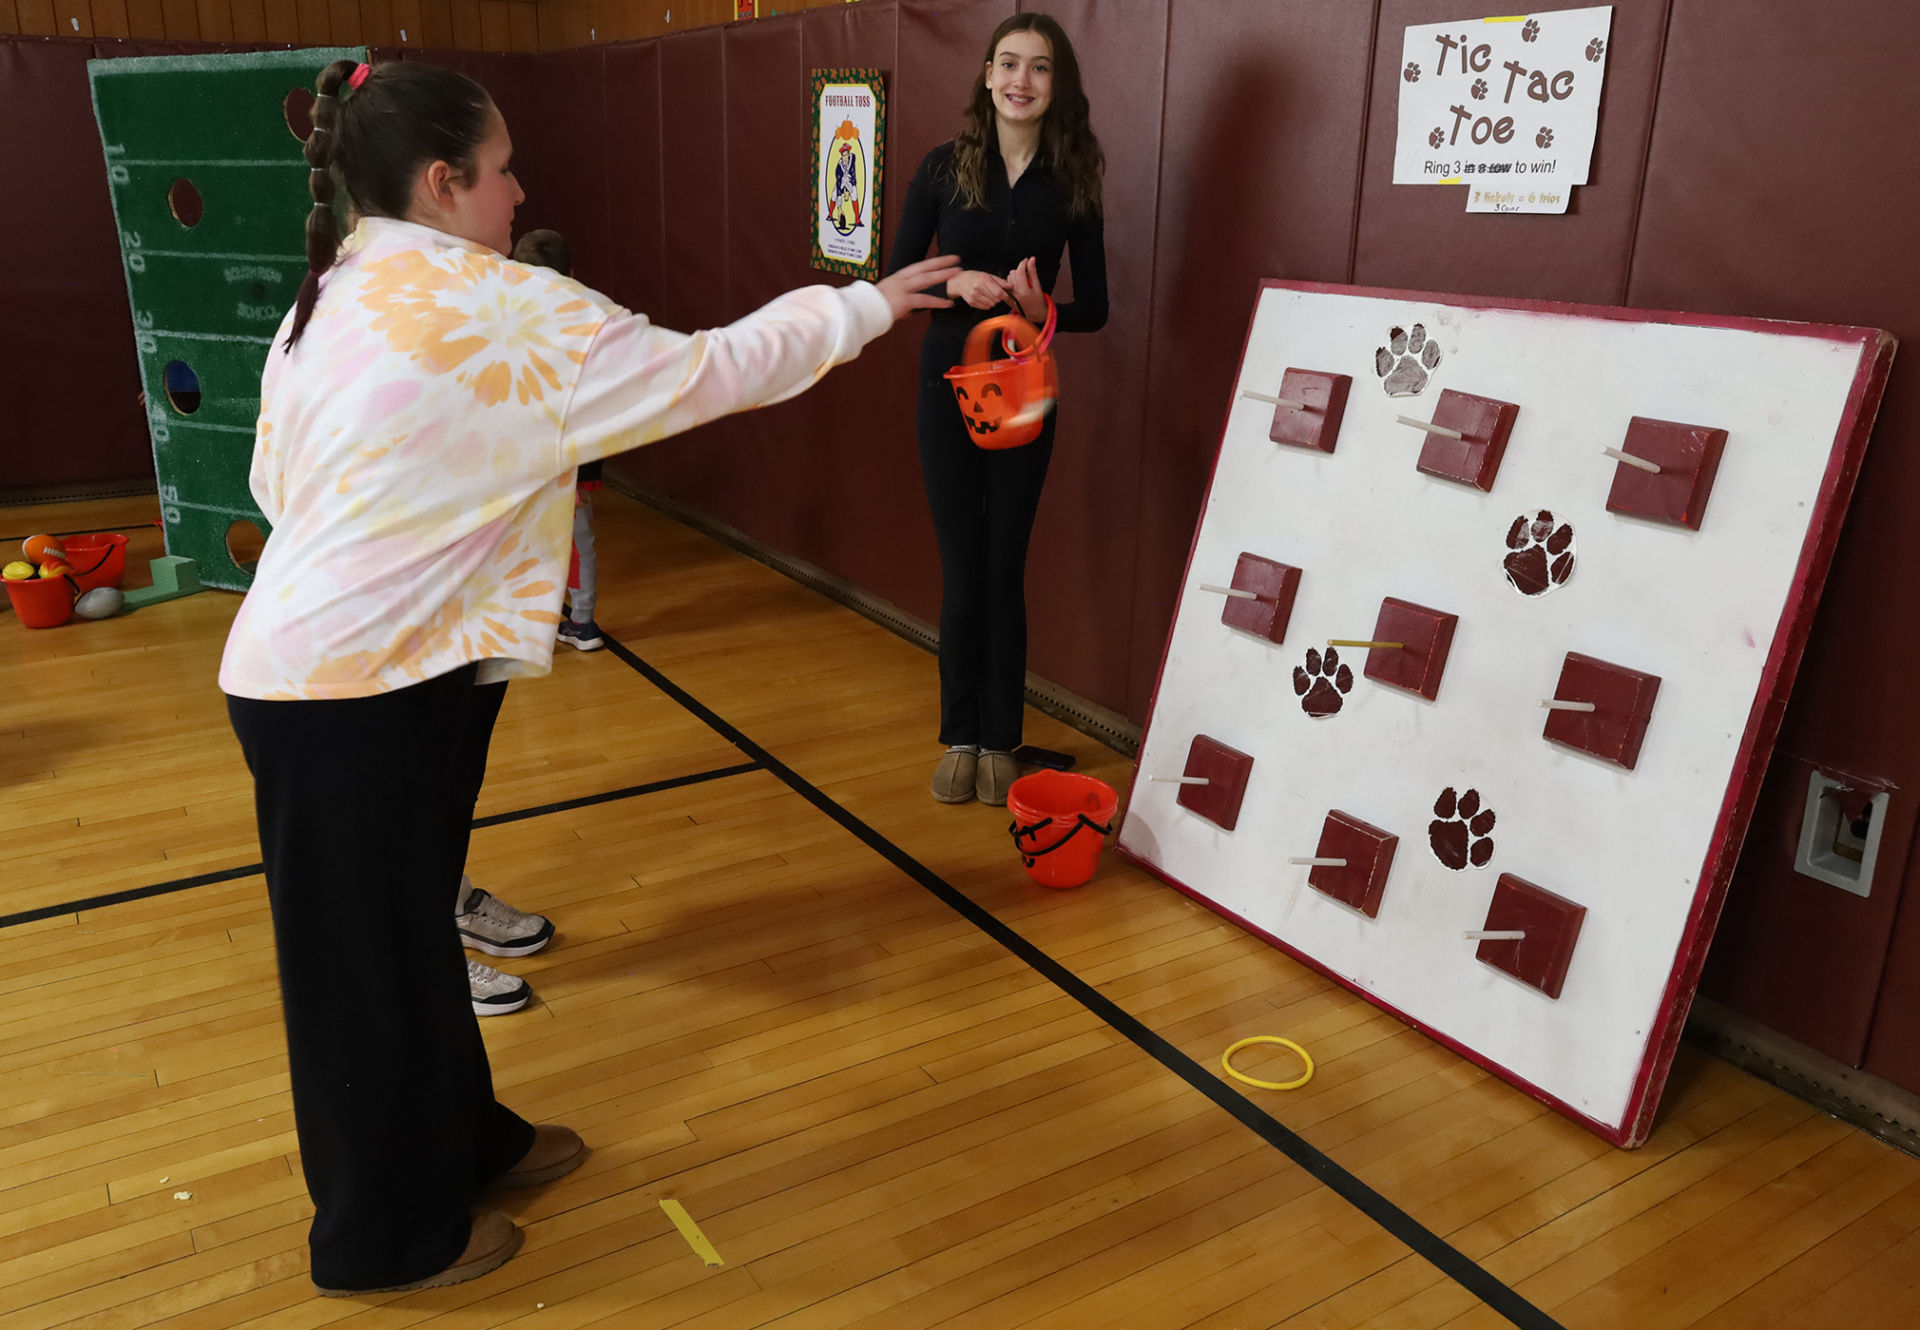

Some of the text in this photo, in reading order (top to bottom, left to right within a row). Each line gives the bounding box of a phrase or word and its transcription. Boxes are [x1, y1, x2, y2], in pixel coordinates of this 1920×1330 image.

[1435, 34, 1492, 76] Tic
[1503, 60, 1575, 104] Tac
[825, 95, 871, 108] FOOTBALL TOSS
[1449, 104, 1516, 146] Toe
[1424, 160, 1450, 177] Ring
[1453, 160, 1461, 174] 3
[1515, 160, 1527, 174] to
[1531, 159, 1557, 174] win!
[1474, 191, 1481, 203] 3
[1528, 191, 1536, 204] 6
